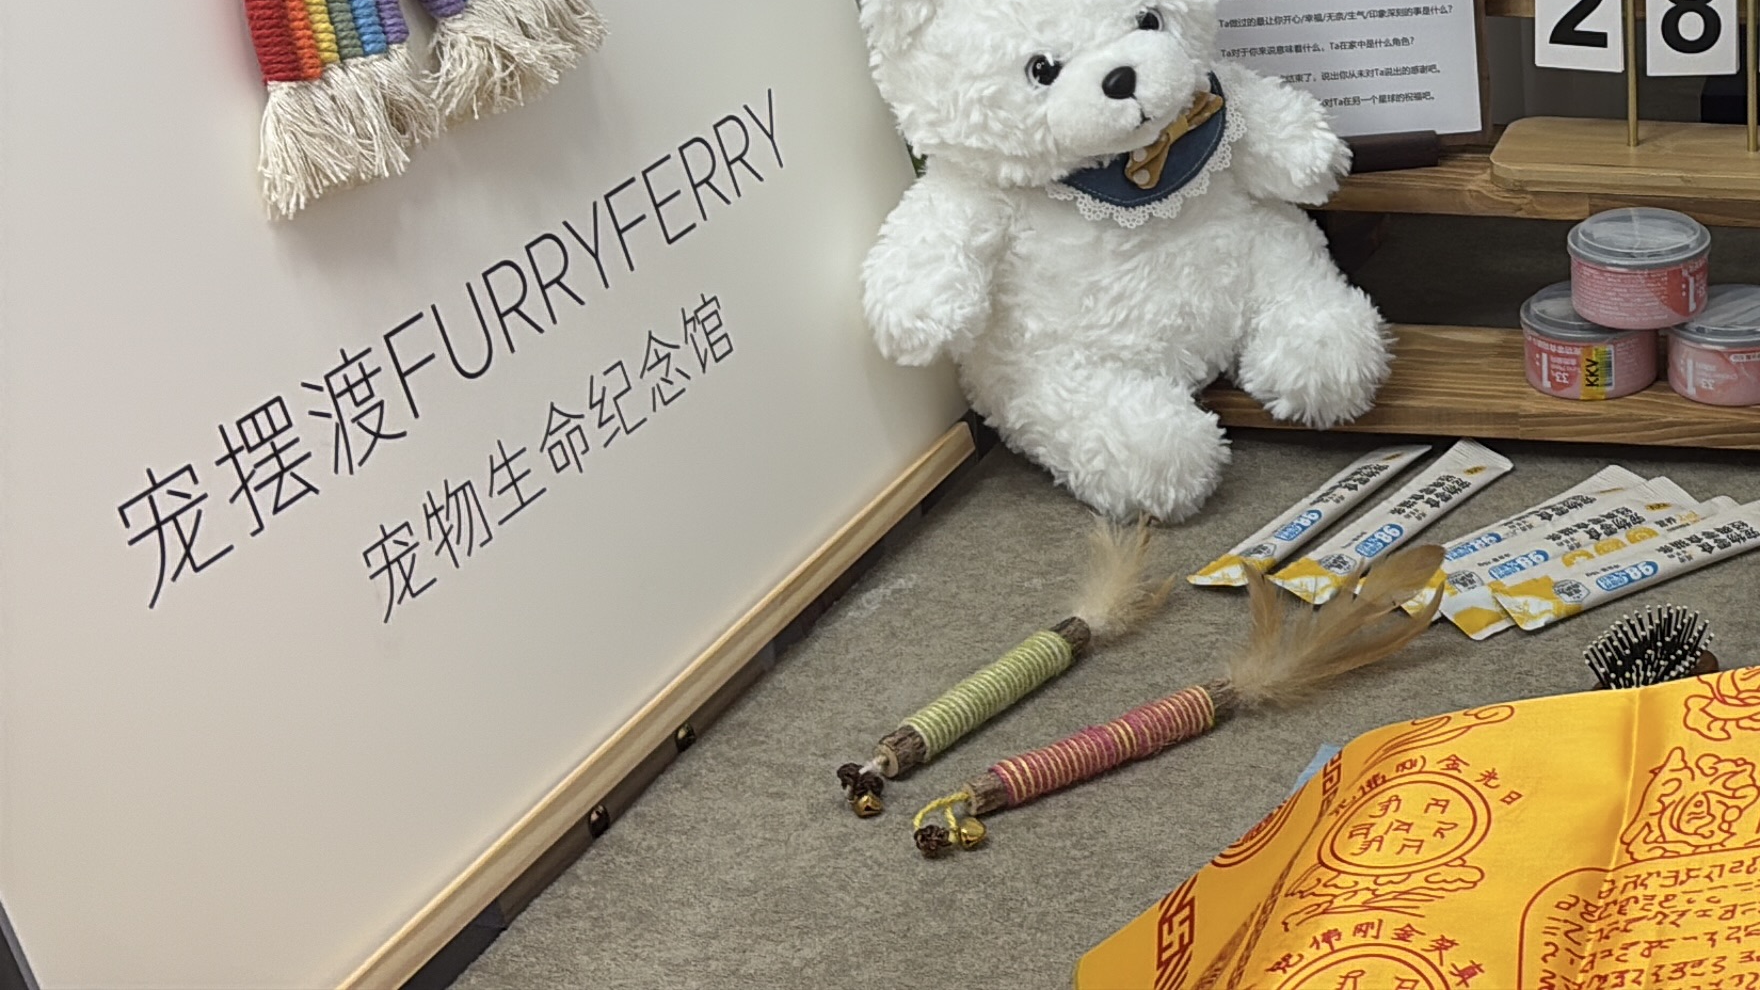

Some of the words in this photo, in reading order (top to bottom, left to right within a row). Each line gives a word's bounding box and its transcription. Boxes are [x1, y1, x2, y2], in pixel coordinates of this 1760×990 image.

[362, 293, 734, 624] 宠物生命纪念馆
[1585, 357, 1599, 387] KKV
